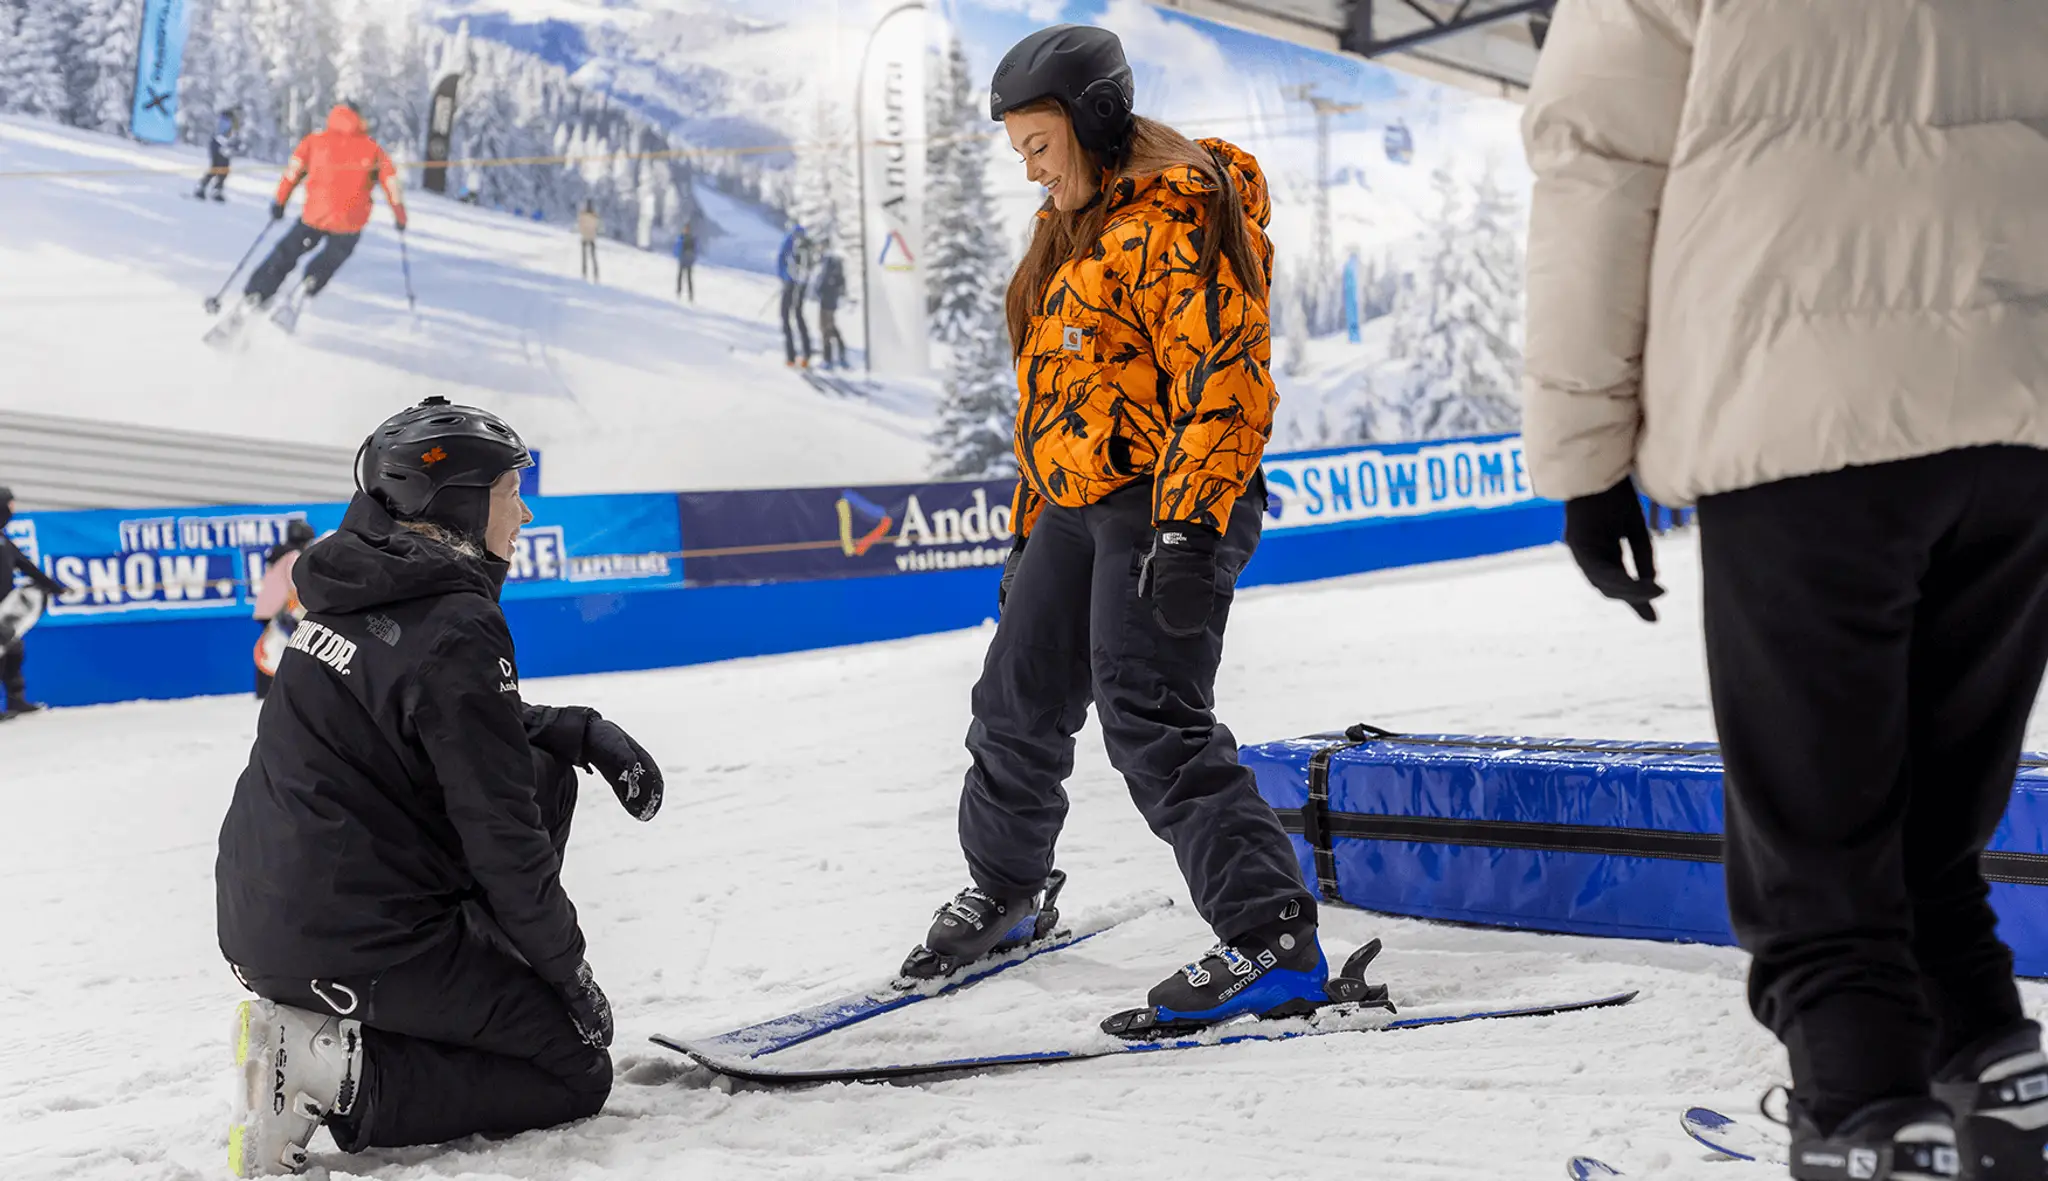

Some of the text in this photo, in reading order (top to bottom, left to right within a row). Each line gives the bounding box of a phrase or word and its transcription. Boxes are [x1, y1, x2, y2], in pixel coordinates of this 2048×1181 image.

[1303, 449, 1528, 516] SNOWDOME
[125, 518, 289, 552] THE ULTIMAT
[895, 488, 1013, 547] Ando
[895, 546, 1013, 571] visitandor
